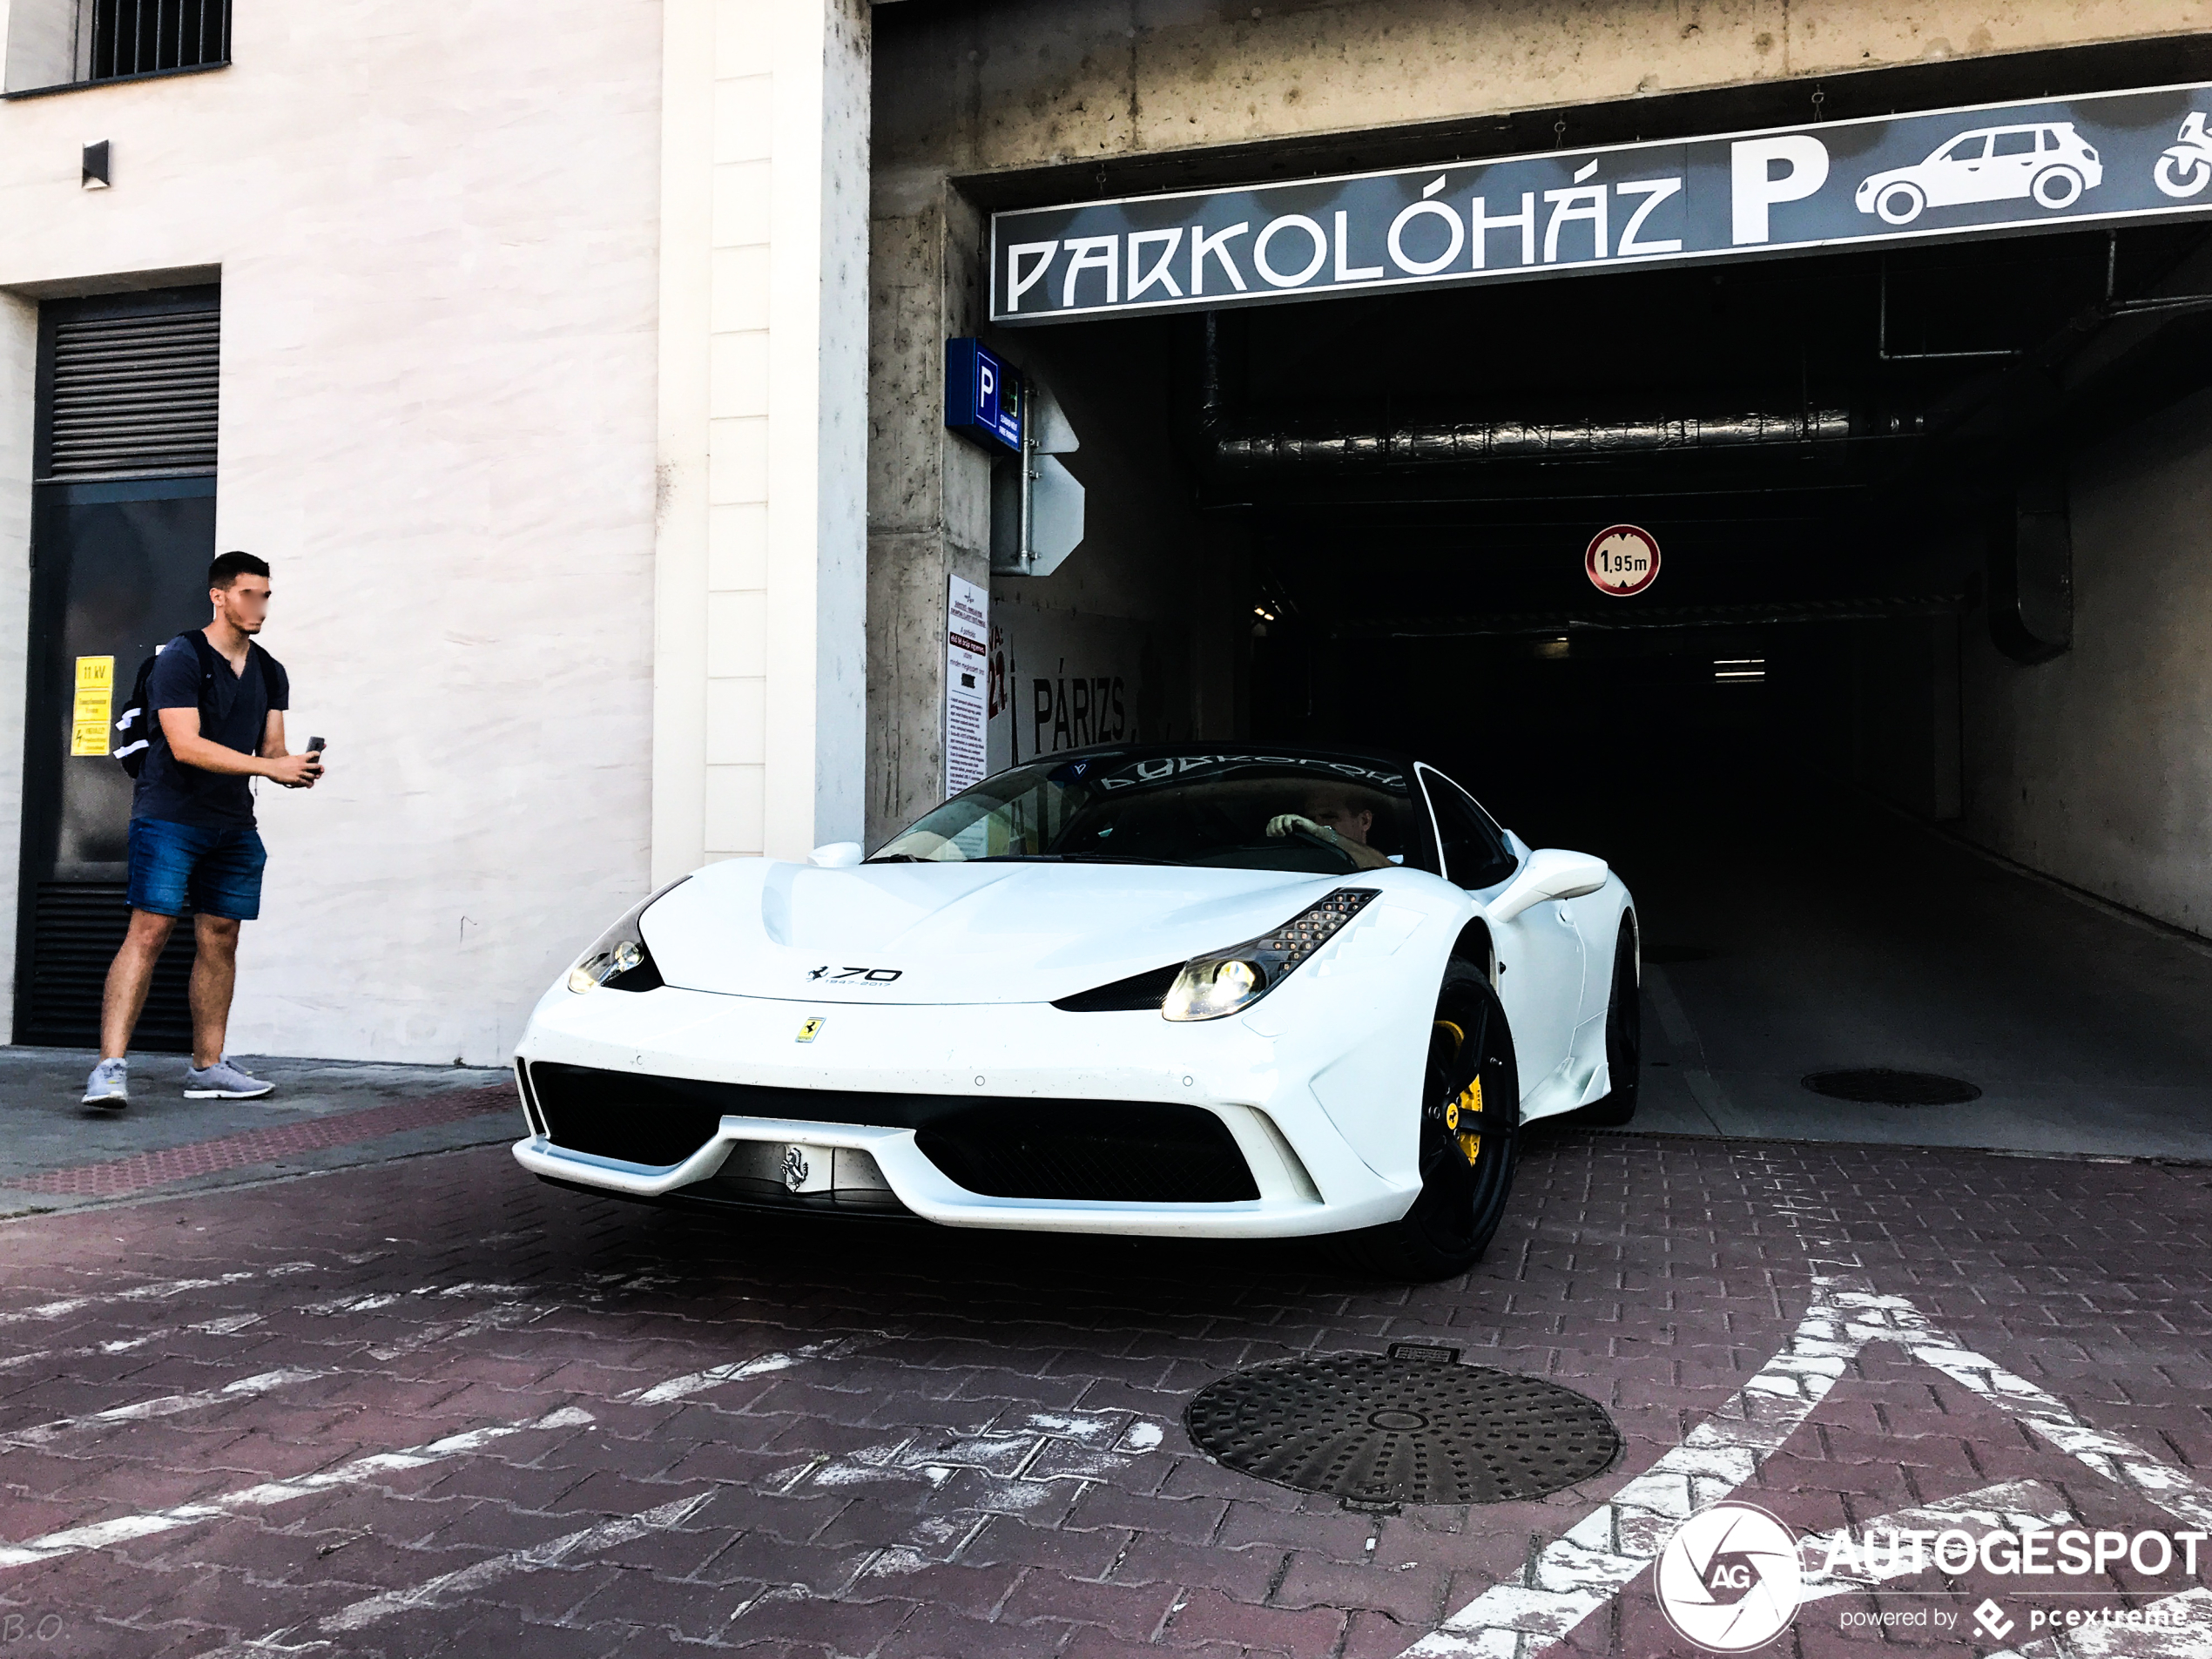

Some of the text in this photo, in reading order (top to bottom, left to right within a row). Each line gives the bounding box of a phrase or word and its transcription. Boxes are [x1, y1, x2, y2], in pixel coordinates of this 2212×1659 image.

[1008, 135, 1830, 312] PARKOLÓHÁZ P
[981, 365, 994, 408] P
[1034, 658, 1125, 754] PÁRIZS
[830, 967, 902, 981] 70
